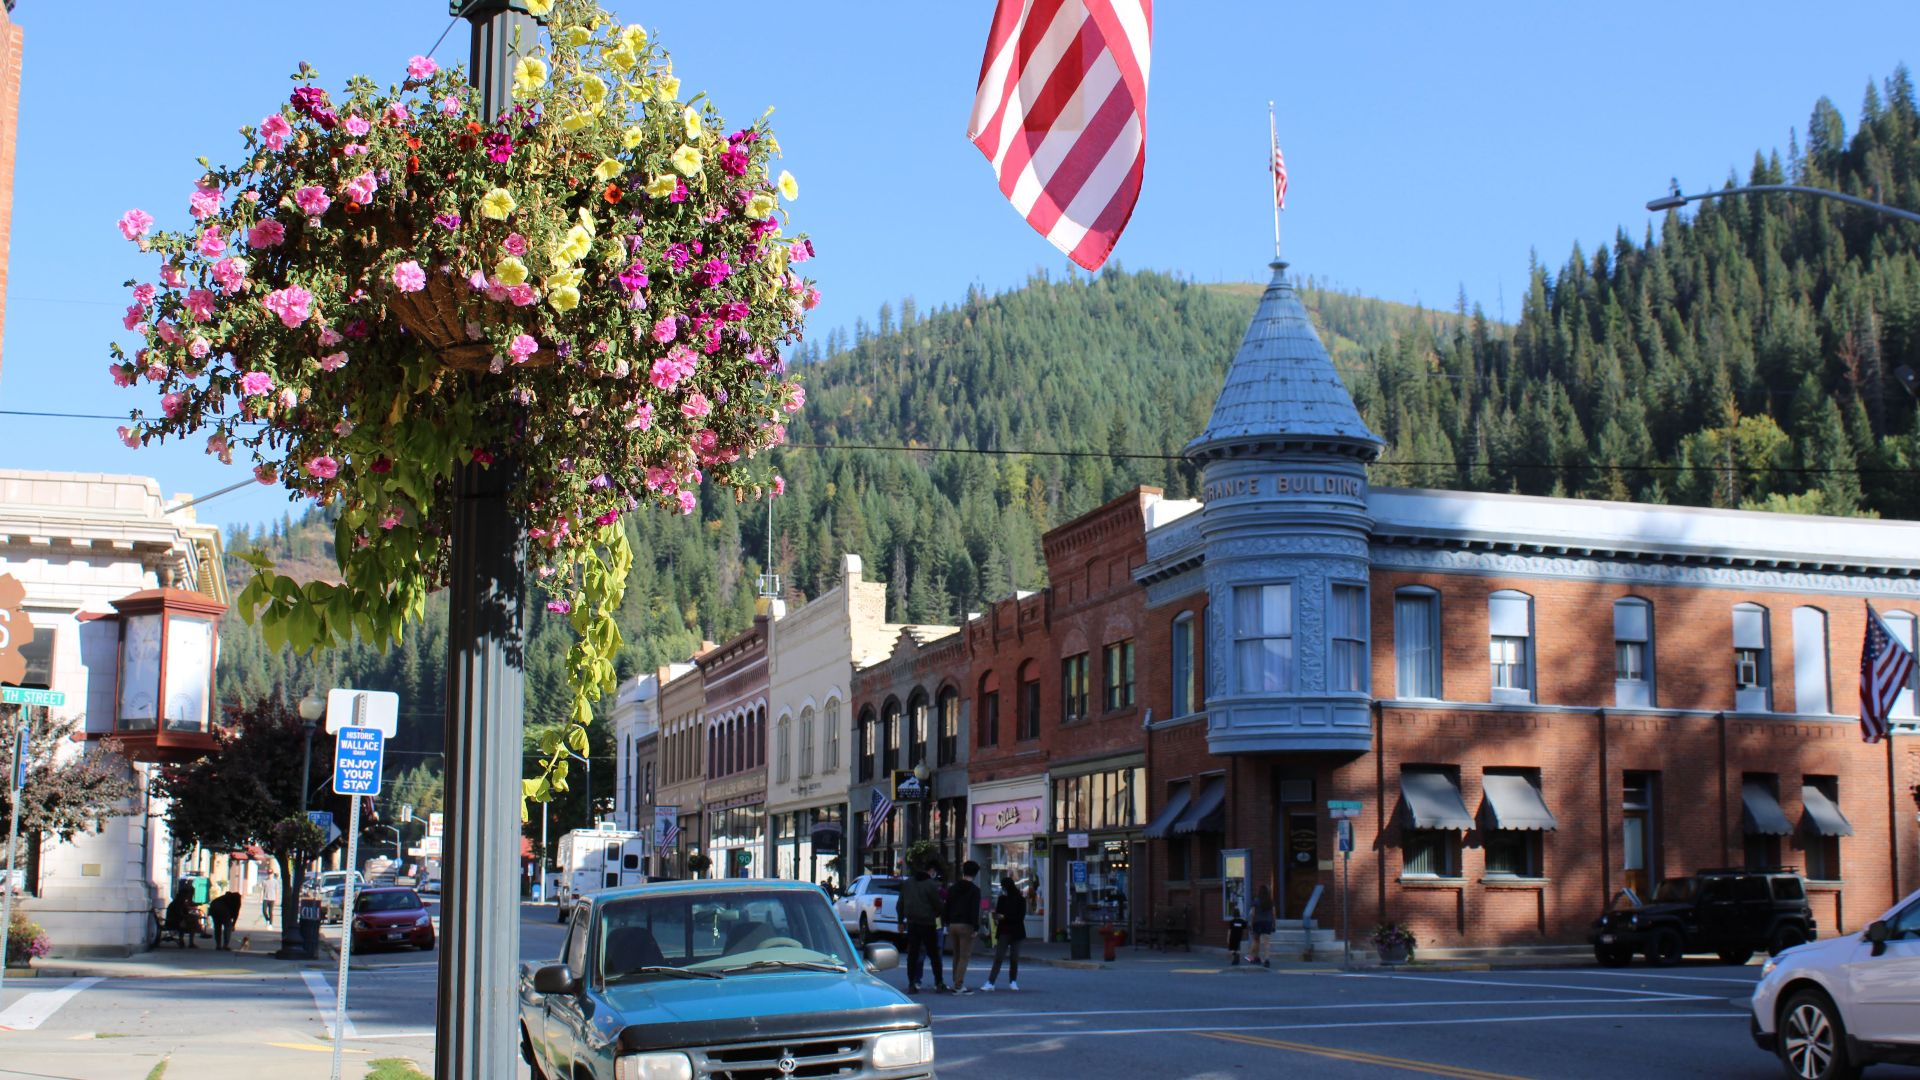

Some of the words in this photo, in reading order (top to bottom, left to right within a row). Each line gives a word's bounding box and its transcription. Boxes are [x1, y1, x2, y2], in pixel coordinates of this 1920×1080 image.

[1277, 476, 1360, 497] BUILDING
[4, 689, 19, 701] TH
[23, 691, 64, 705] STREET
[346, 731, 375, 740] HISTORIC
[341, 740, 379, 751] WALLACE
[339, 758, 377, 769] ENJOY
[343, 769, 374, 780] YOUR
[342, 780, 371, 790] STAY
[739, 855, 750, 864] 90
